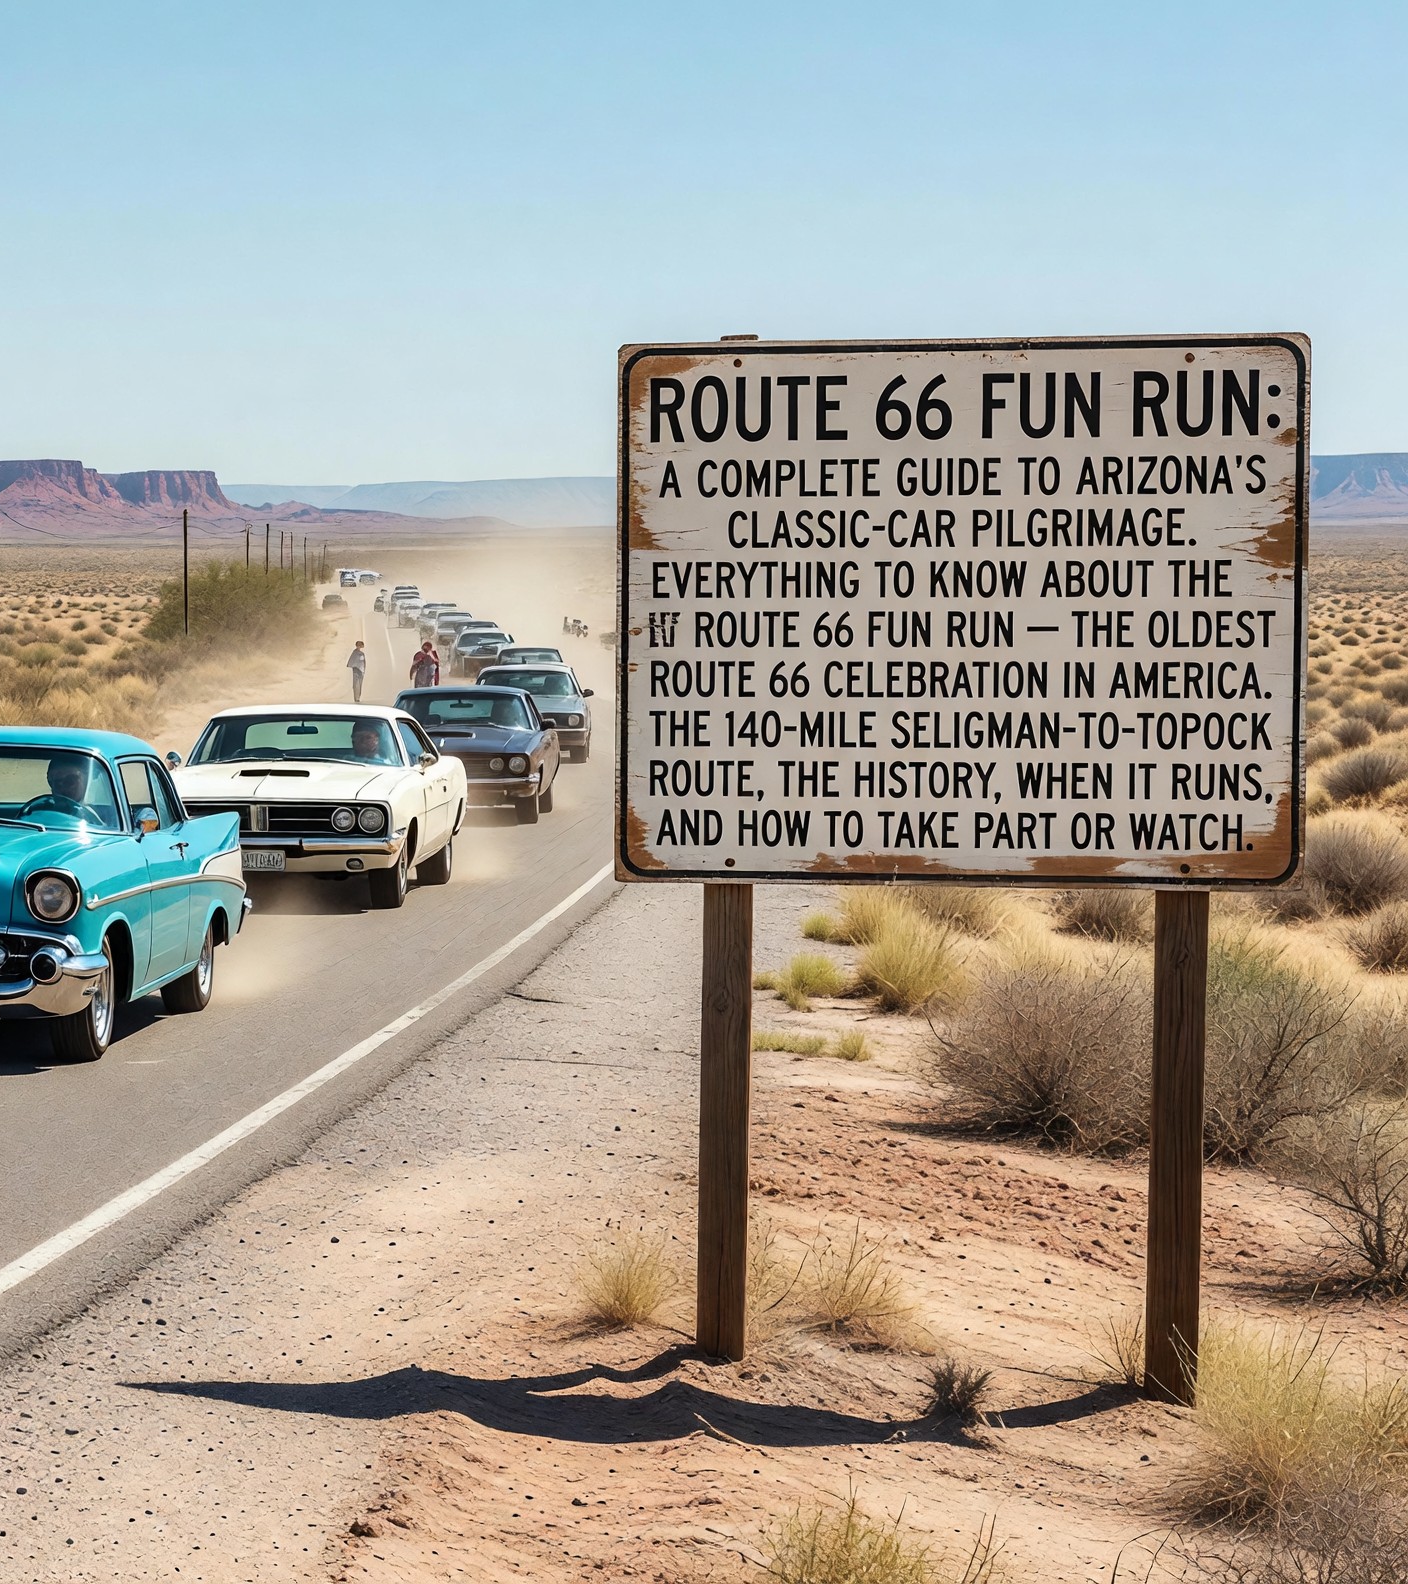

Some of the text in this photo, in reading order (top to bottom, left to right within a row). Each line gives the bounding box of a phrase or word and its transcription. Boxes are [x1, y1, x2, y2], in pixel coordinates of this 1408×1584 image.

[650, 369, 1282, 443] ROUTE 66 FUN RUN:
[659, 455, 1267, 498] A COMPLETE GUIDE TO ARIZONA'S
[728, 508, 1197, 549] CLASSIC-CAR PILGRIMAGE.
[653, 559, 1232, 599] EVERYTHING TO KNOW ABOUT THE
[695, 611, 799, 648] ROUTE
[814, 611, 853, 648] 66
[869, 611, 931, 648] FUN
[947, 611, 1013, 648] RUN
[1072, 611, 1134, 648] THE
[1149, 610, 1276, 648] OLDEST
[651, 660, 1272, 700] ROUTE 66 CELEBRATION IN AMERICA.
[649, 711, 1272, 750] THE 140-MILE SELIGMAN-TO-TOPOCK
[650, 760, 1273, 805] ROUTE, THE HISTORY, WHEN IT RUNS,
[656, 809, 1254, 851] AND HOW TO TAKE PART OR WATCH.
